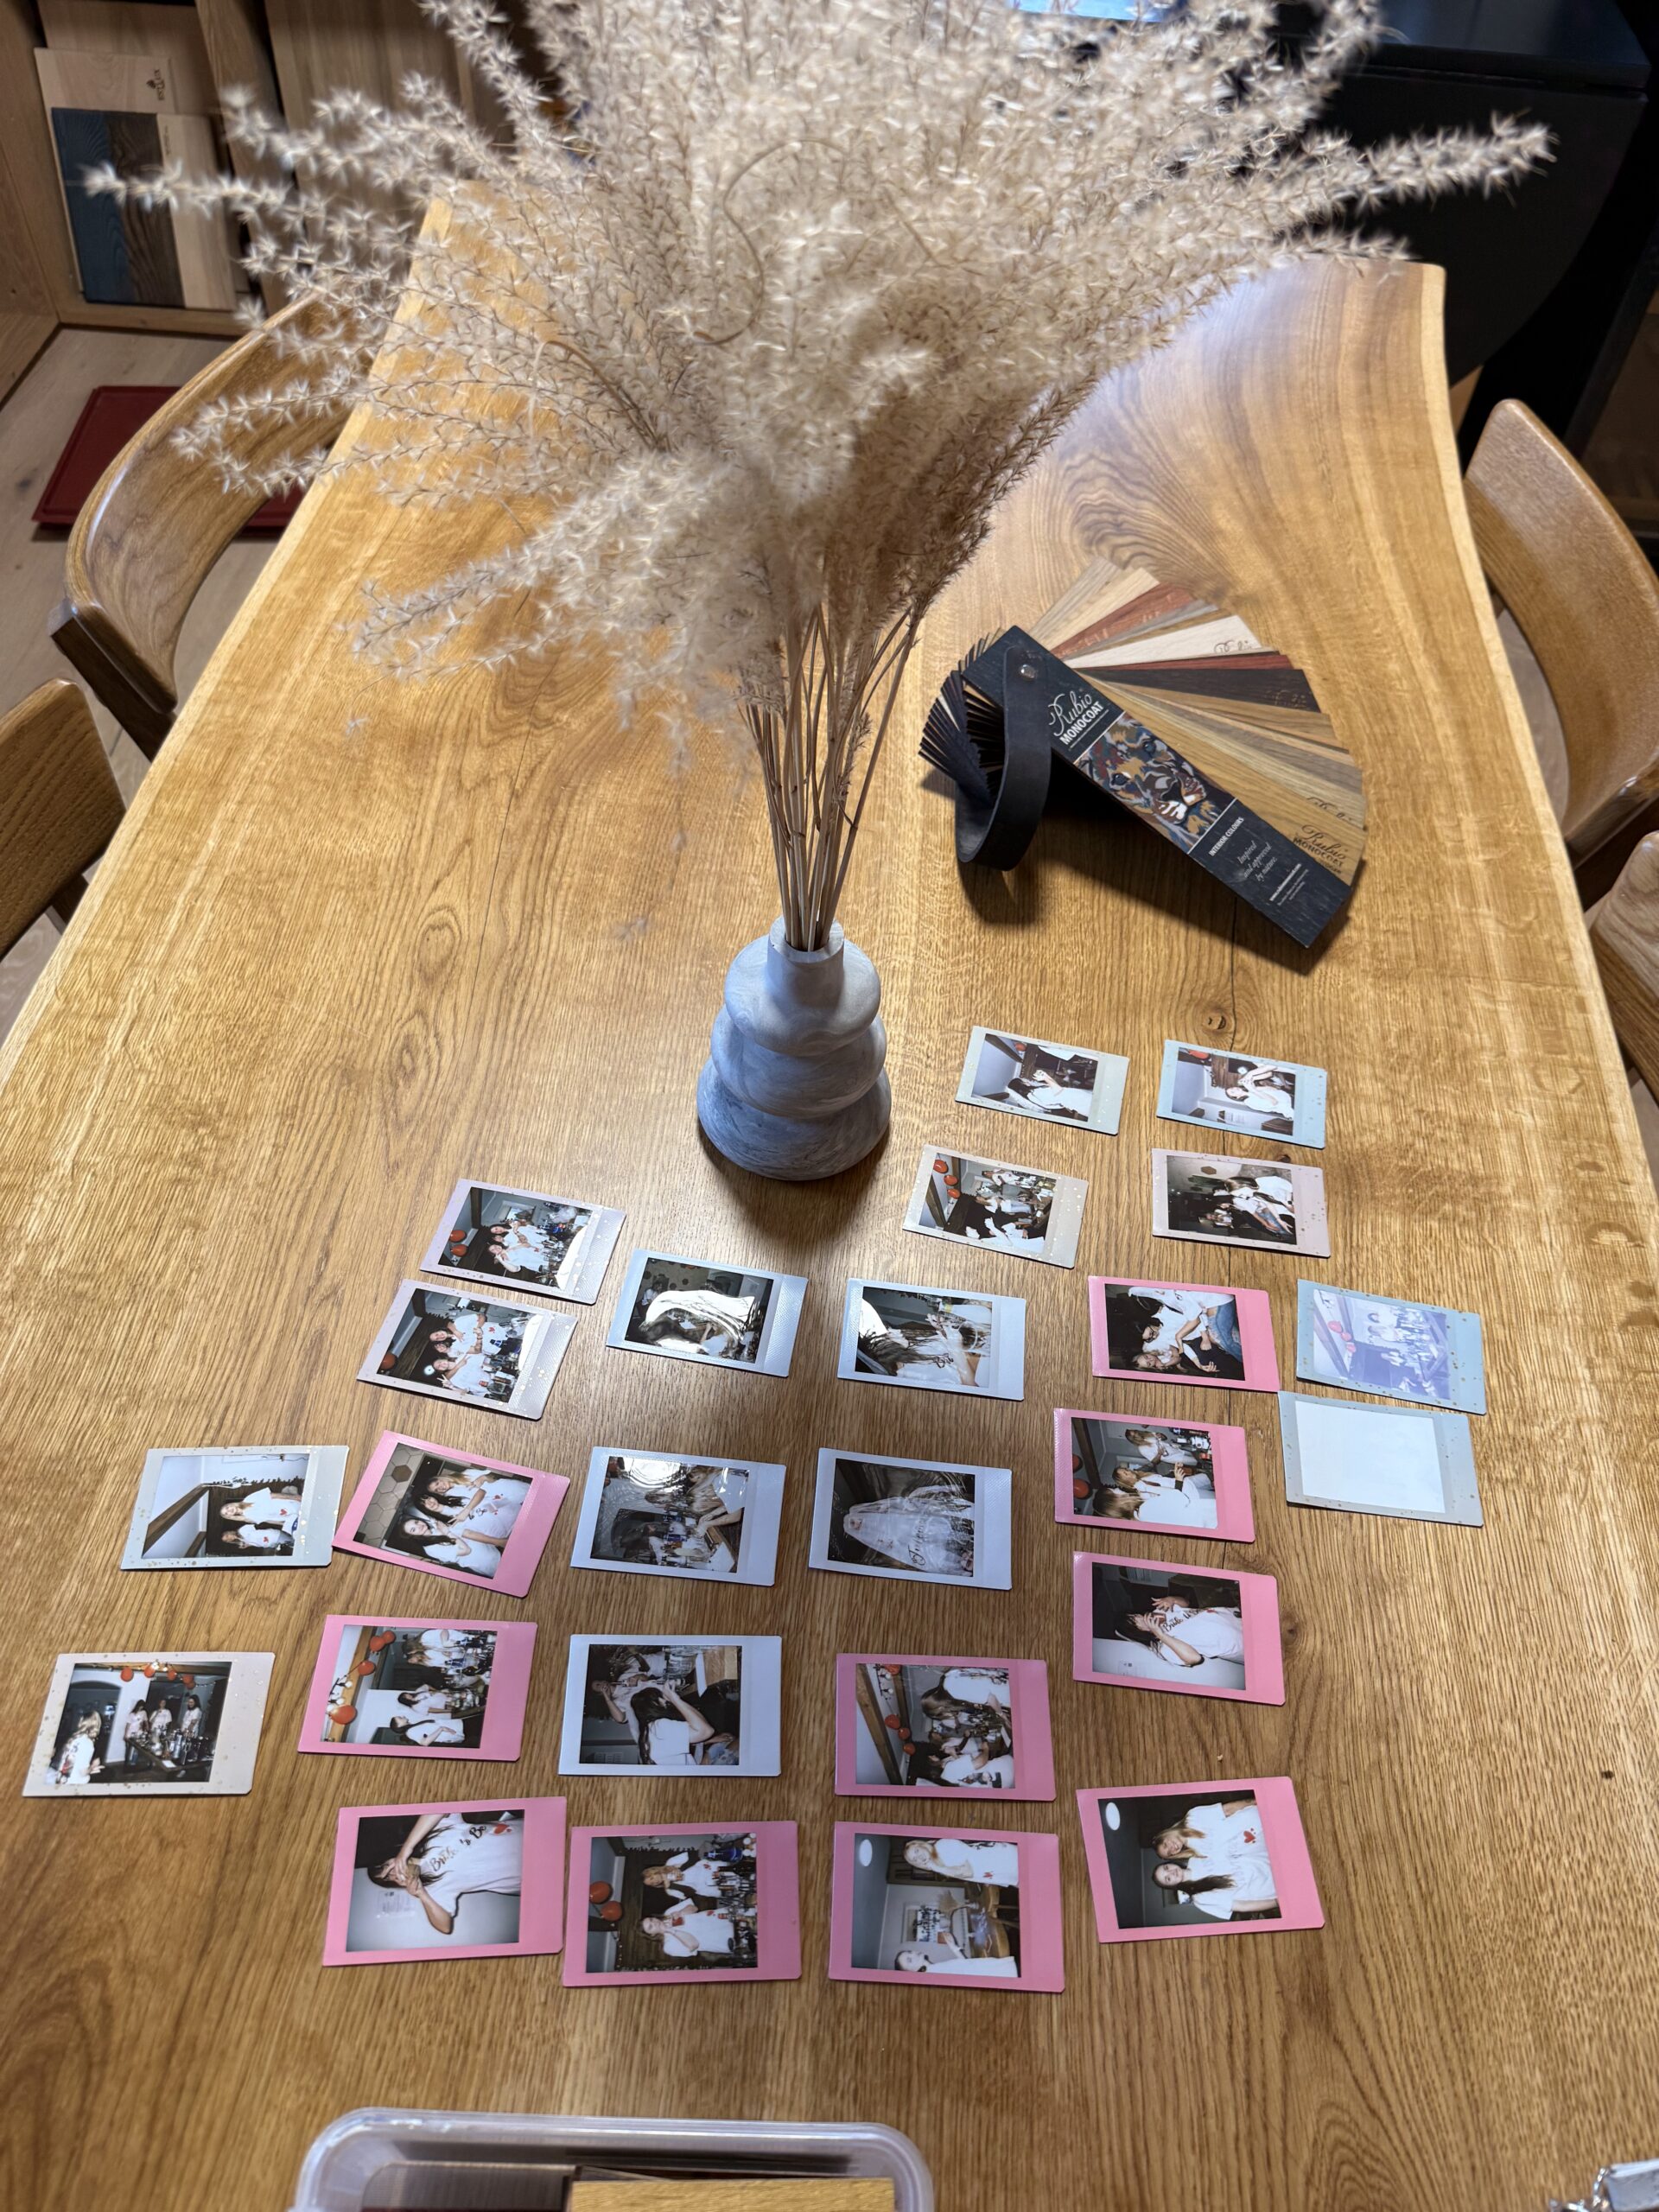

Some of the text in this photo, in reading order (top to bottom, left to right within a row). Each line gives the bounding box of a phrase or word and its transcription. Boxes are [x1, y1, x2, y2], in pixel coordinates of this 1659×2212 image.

[1047, 690, 1092, 737] Rubio
[1059, 701, 1104, 746] MONOCOAT
[1209, 817, 1244, 856] INTERIOR COLOURS
[1237, 840, 1257, 864] Inspired
[1300, 824, 1346, 860] Rubio
[469, 1825, 487, 1840] Be
